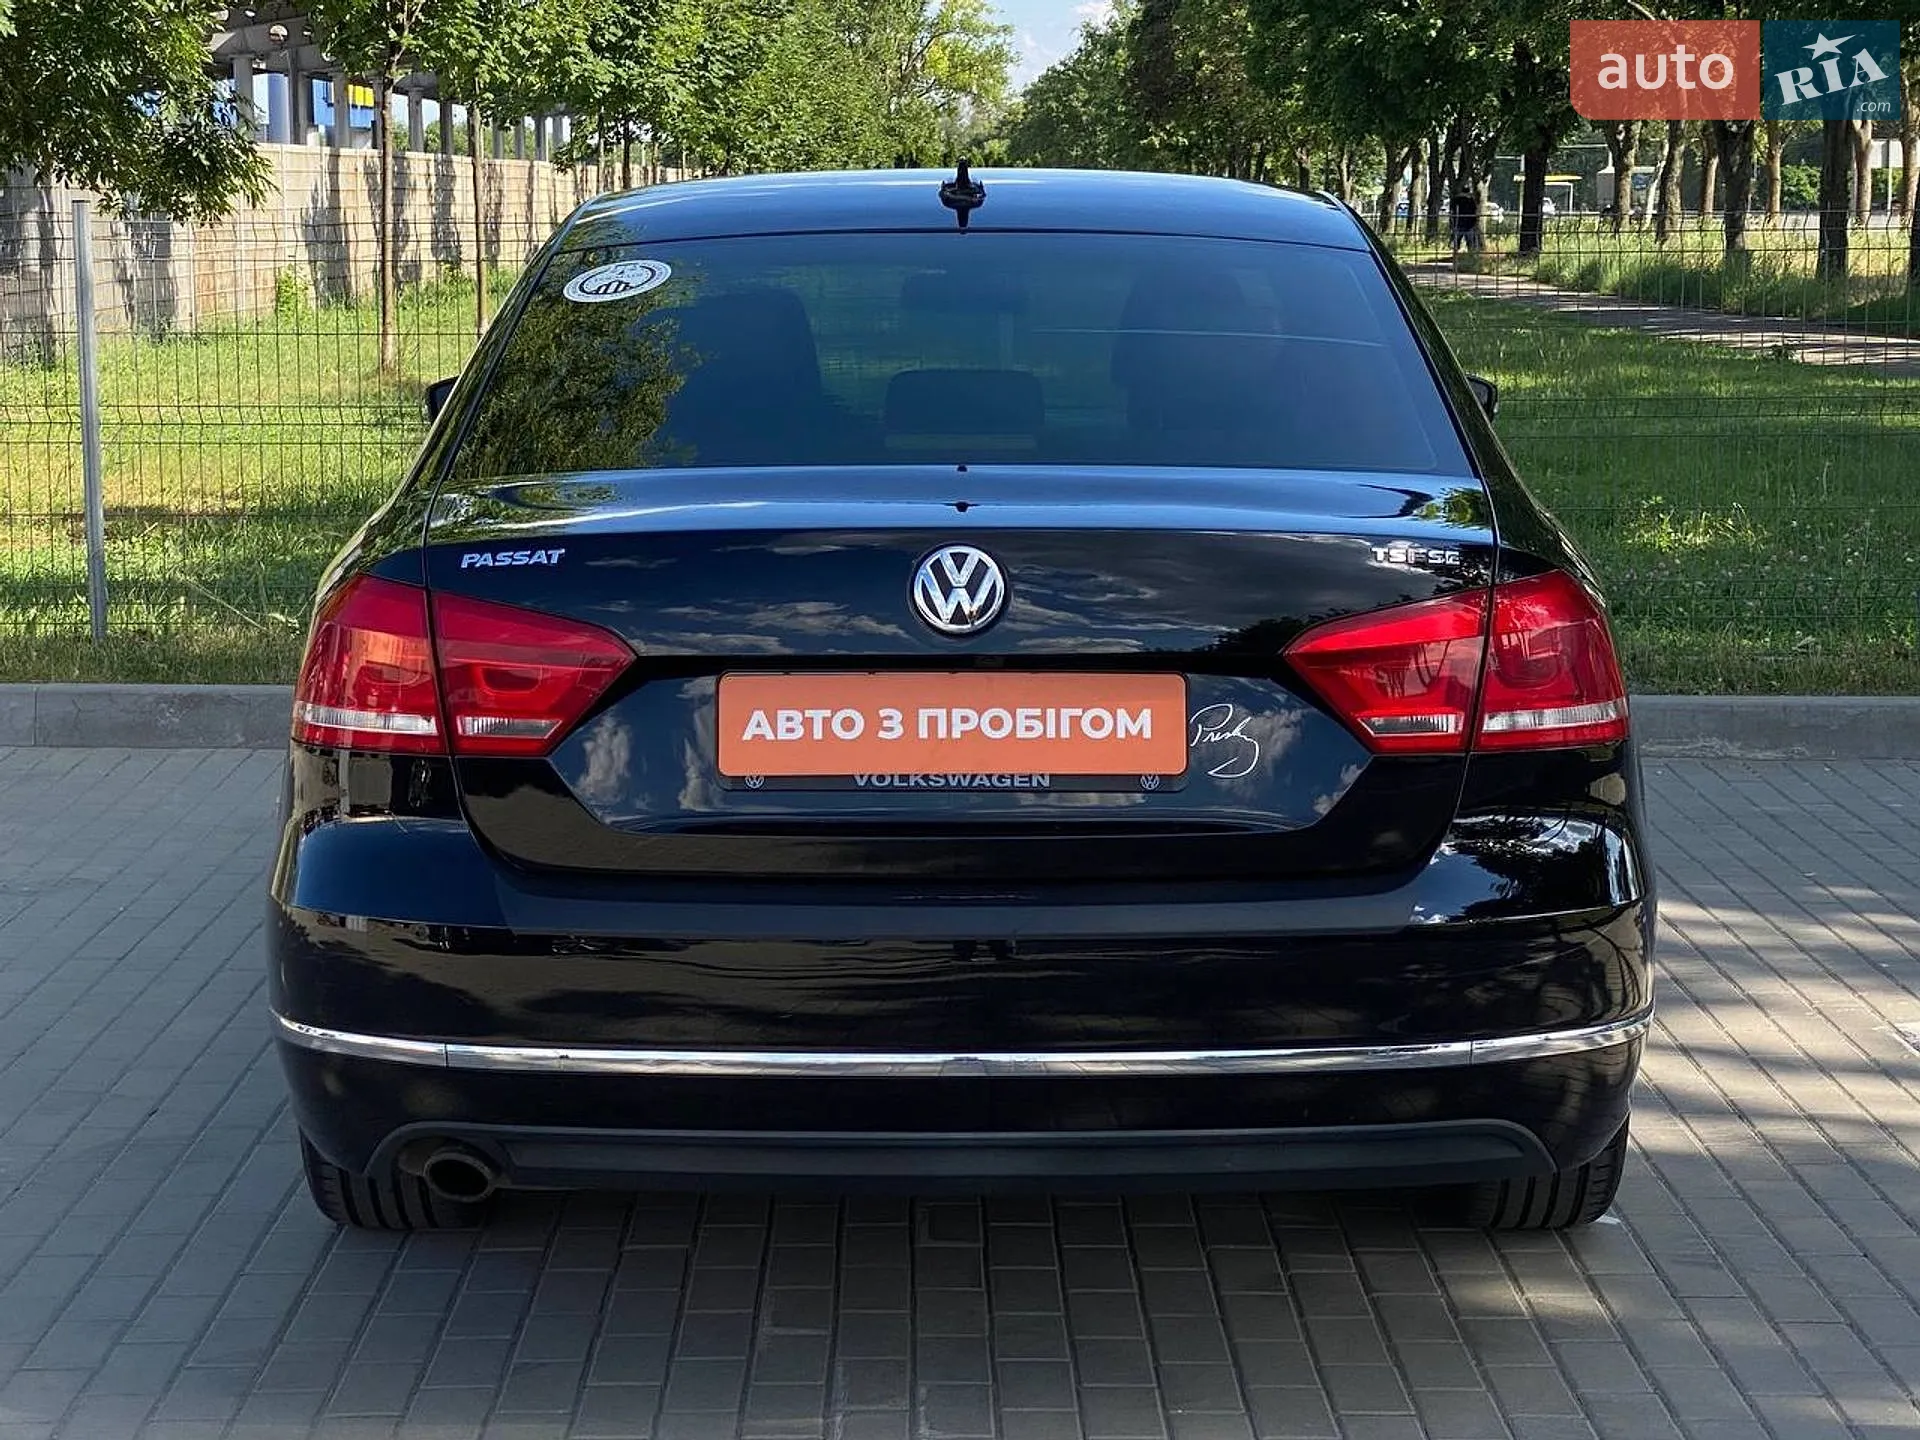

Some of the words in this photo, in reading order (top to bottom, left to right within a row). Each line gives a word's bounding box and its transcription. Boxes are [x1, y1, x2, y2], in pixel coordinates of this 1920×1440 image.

[460, 548, 566, 569] PASSAT
[741, 709, 865, 741] АВТО
[877, 708, 904, 740] З
[917, 707, 1153, 740] ПРОБІГОМ
[853, 773, 1051, 787] VOLKSWAGEN
